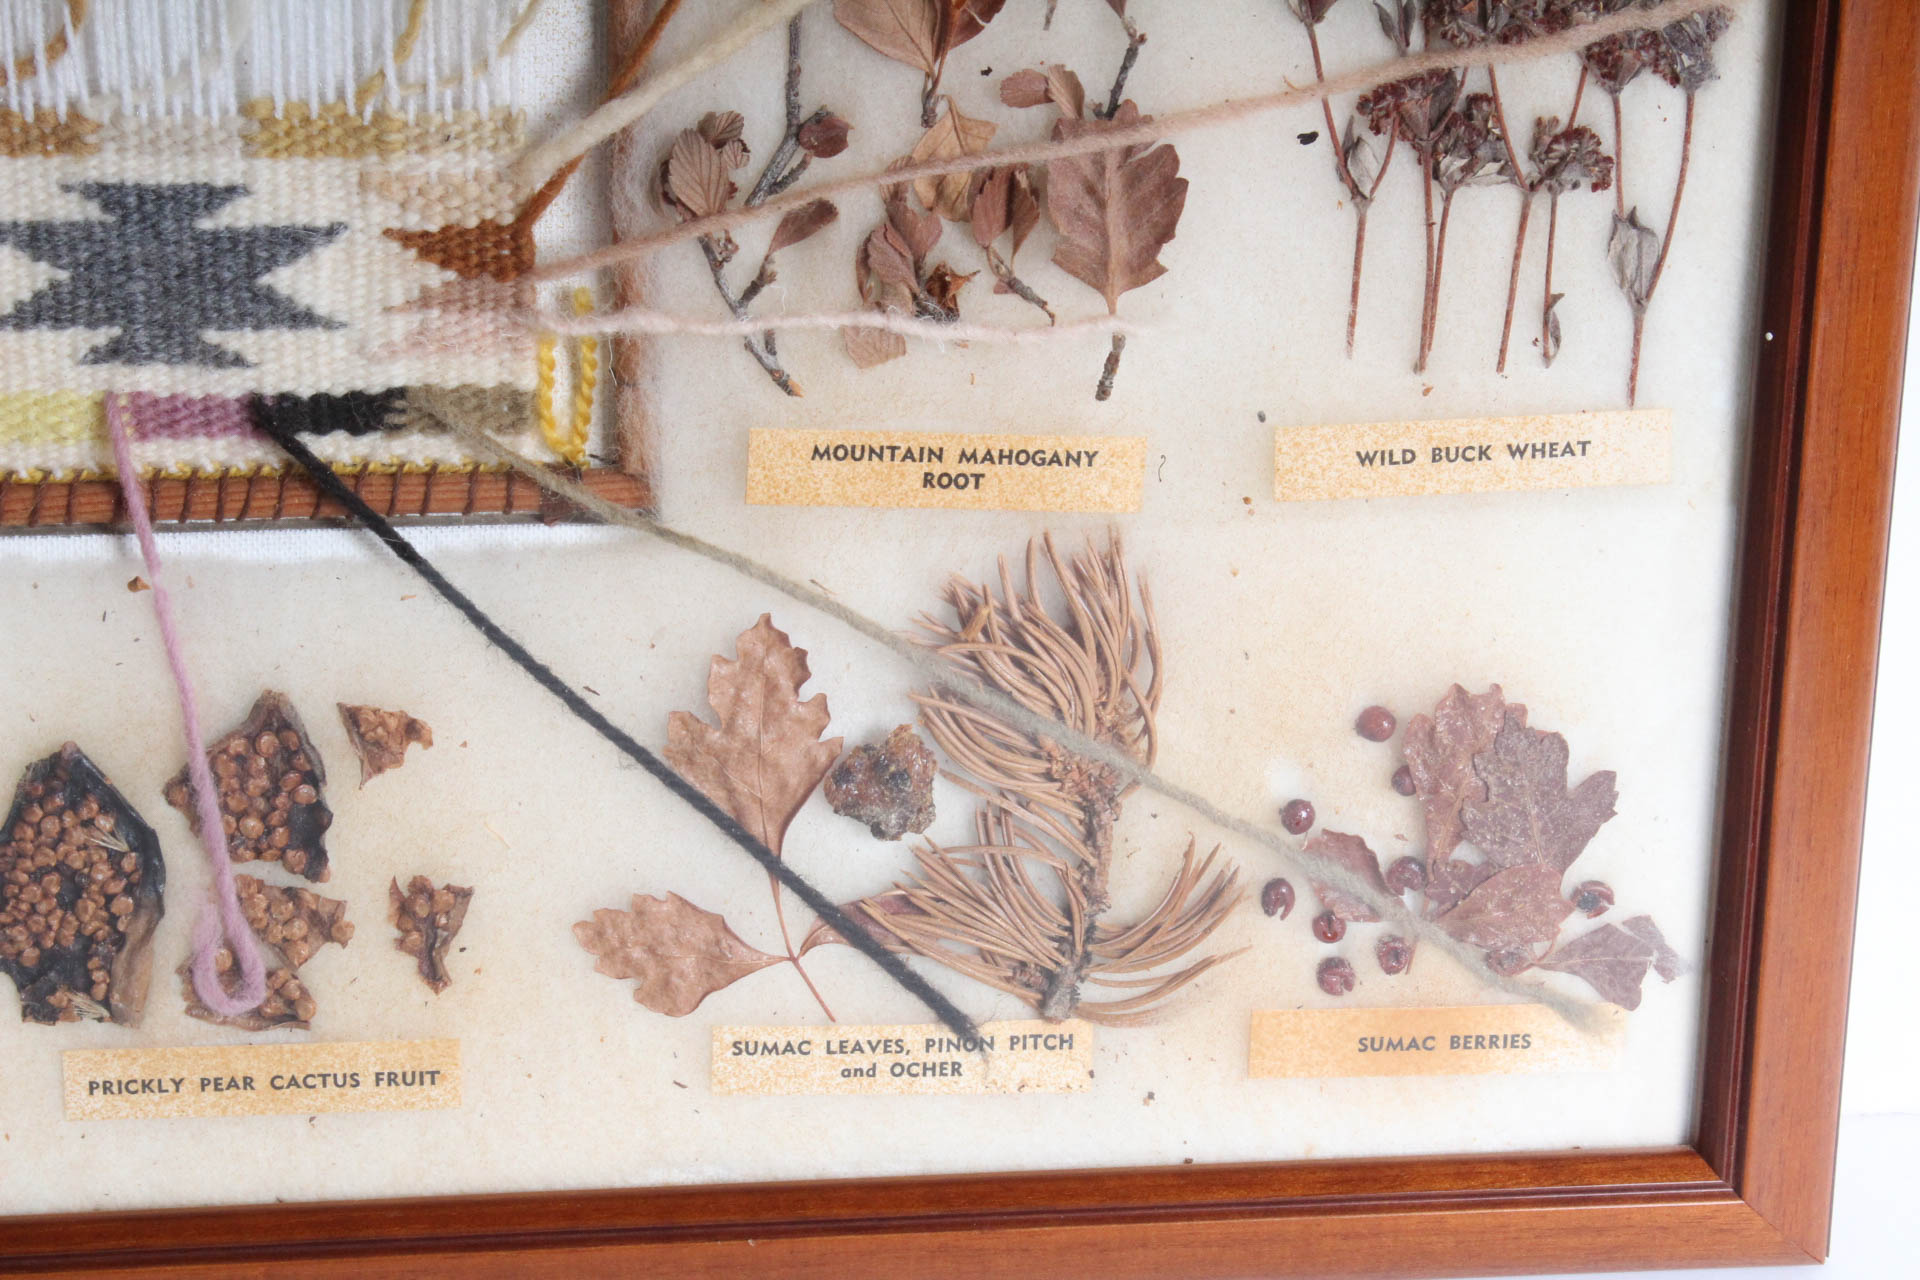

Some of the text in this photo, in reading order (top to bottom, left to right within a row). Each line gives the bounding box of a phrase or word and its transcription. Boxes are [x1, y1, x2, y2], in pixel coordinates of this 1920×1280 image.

[811, 443, 1099, 467] MOUNTAIN MAHOGANY
[1356, 440, 1592, 467] WILD BUCK WHEAT
[921, 471, 987, 490] ROOT
[731, 1040, 811, 1056] SUMAC
[825, 1039, 911, 1056] LEAVES,
[1009, 1033, 1075, 1052] PITCH
[1356, 1033, 1533, 1053] SUMAC BERRIES
[840, 1061, 964, 1079] and OCHER
[87, 1069, 442, 1097] PRICKLY PEAR CACTUS FRUIT
